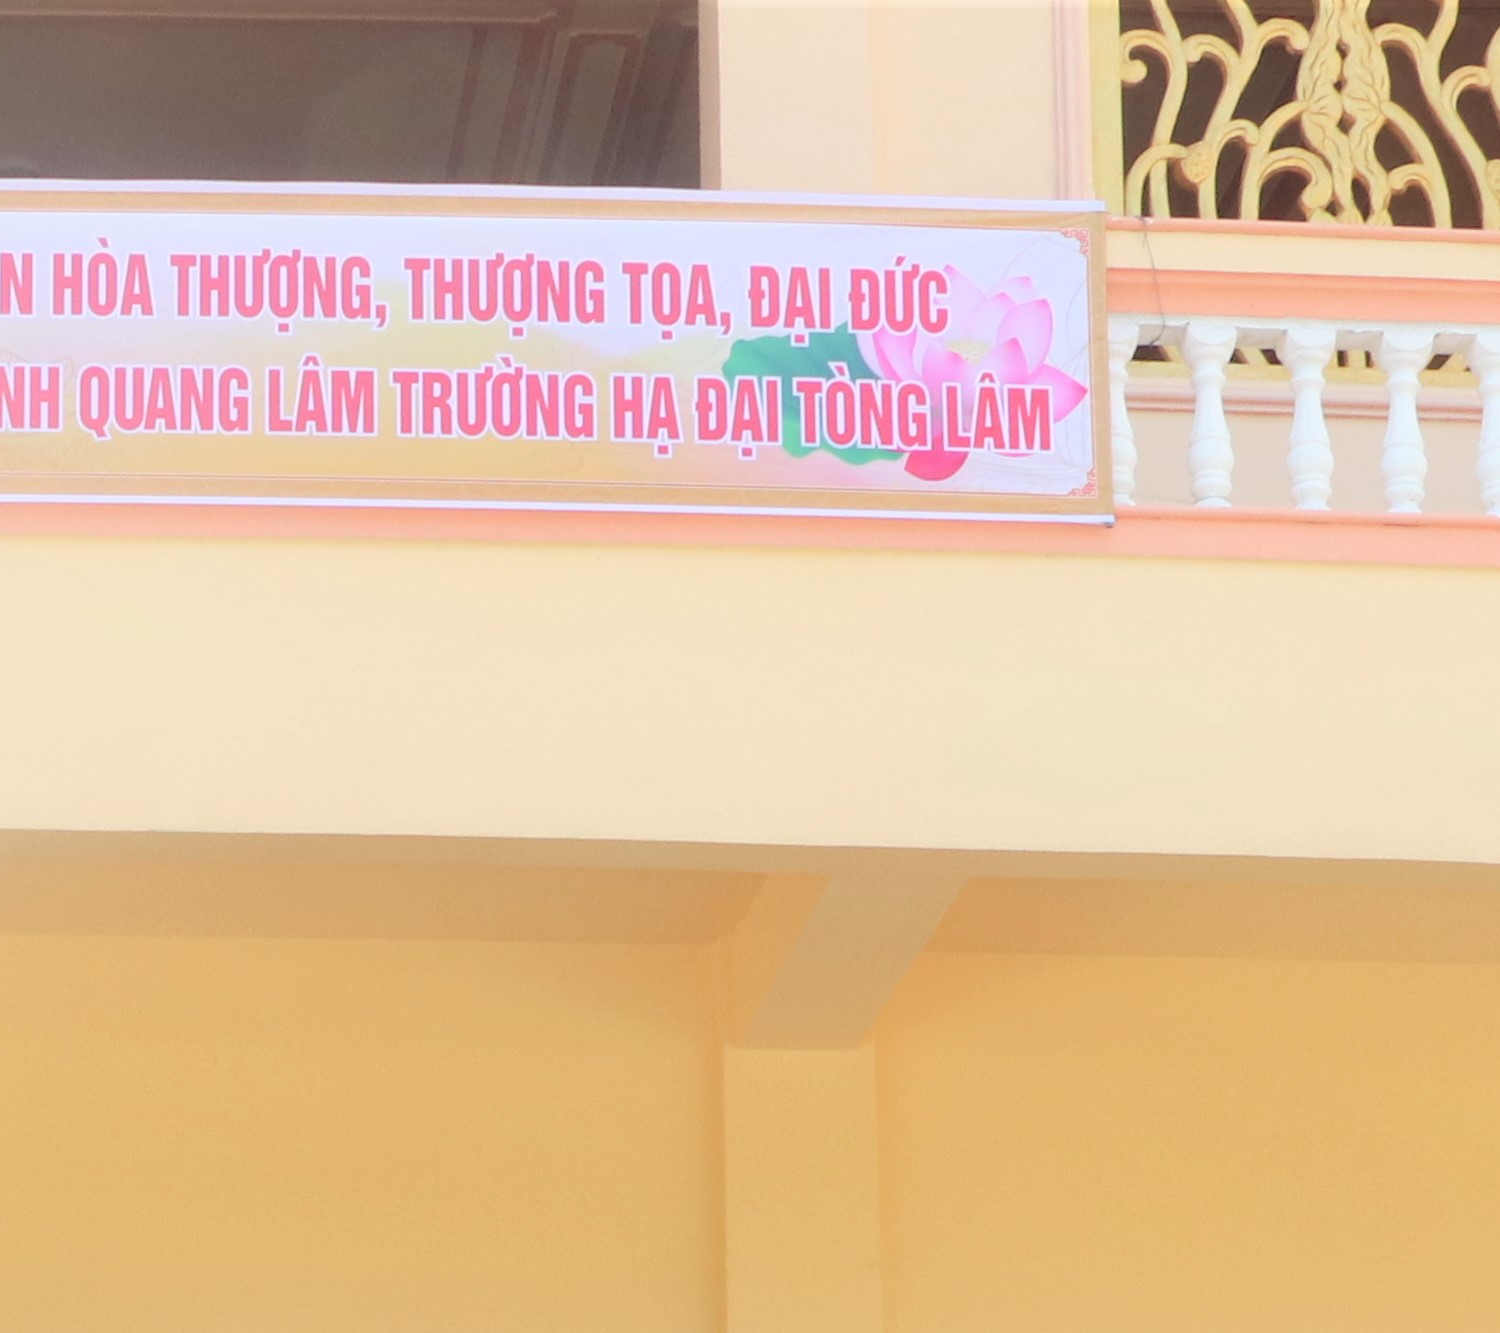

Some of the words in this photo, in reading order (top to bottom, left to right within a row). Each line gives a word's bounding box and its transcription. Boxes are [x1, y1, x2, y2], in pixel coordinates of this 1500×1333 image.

[52, 236, 155, 318] HÒA
[168, 247, 389, 334] THƯỢNG,
[403, 251, 607, 338] THƯỢNG
[621, 259, 733, 342] TỌA,
[748, 263, 833, 345] ĐẠI
[848, 255, 949, 335] ĐỨC
[78, 364, 251, 440] QUANG
[267, 354, 377, 434] LÂM
[392, 355, 597, 438] TRƯỜNG
[612, 374, 681, 456] HẠ
[694, 376, 780, 458] ĐẠI
[796, 364, 929, 449] TÒNG
[945, 371, 1052, 451] LÂM
